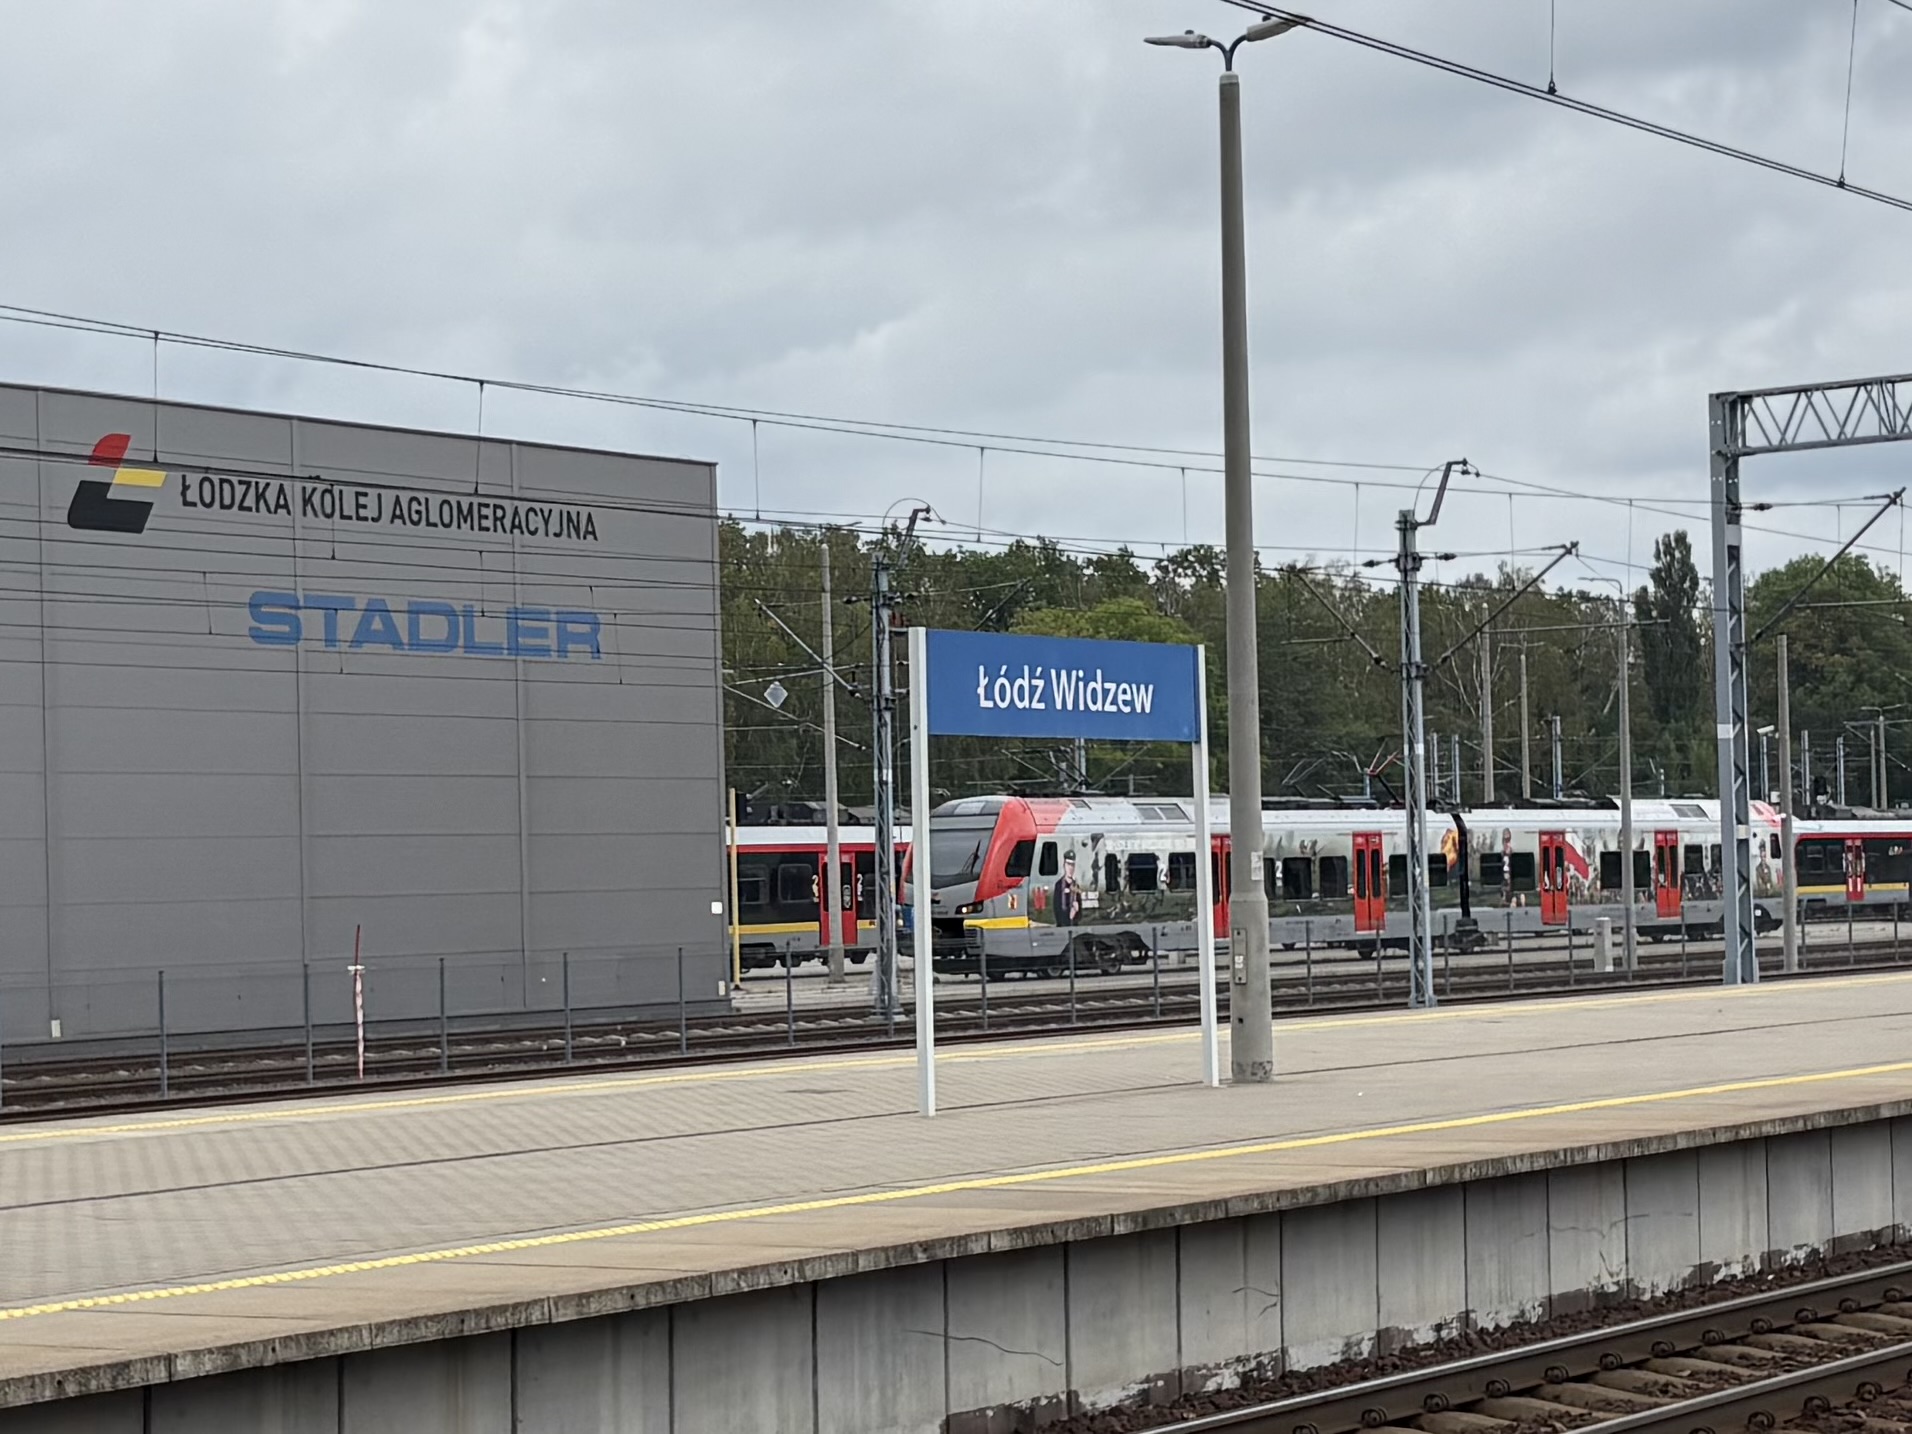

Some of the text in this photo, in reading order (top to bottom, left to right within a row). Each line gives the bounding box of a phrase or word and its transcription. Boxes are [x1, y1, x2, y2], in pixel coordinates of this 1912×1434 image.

[302, 484, 382, 523] KOLEJ
[390, 494, 598, 541] AGLOMERACYJNA
[248, 591, 602, 659] STADLER
[977, 665, 1154, 714] Łódź Widzew
[1275, 861, 1282, 877] 2
